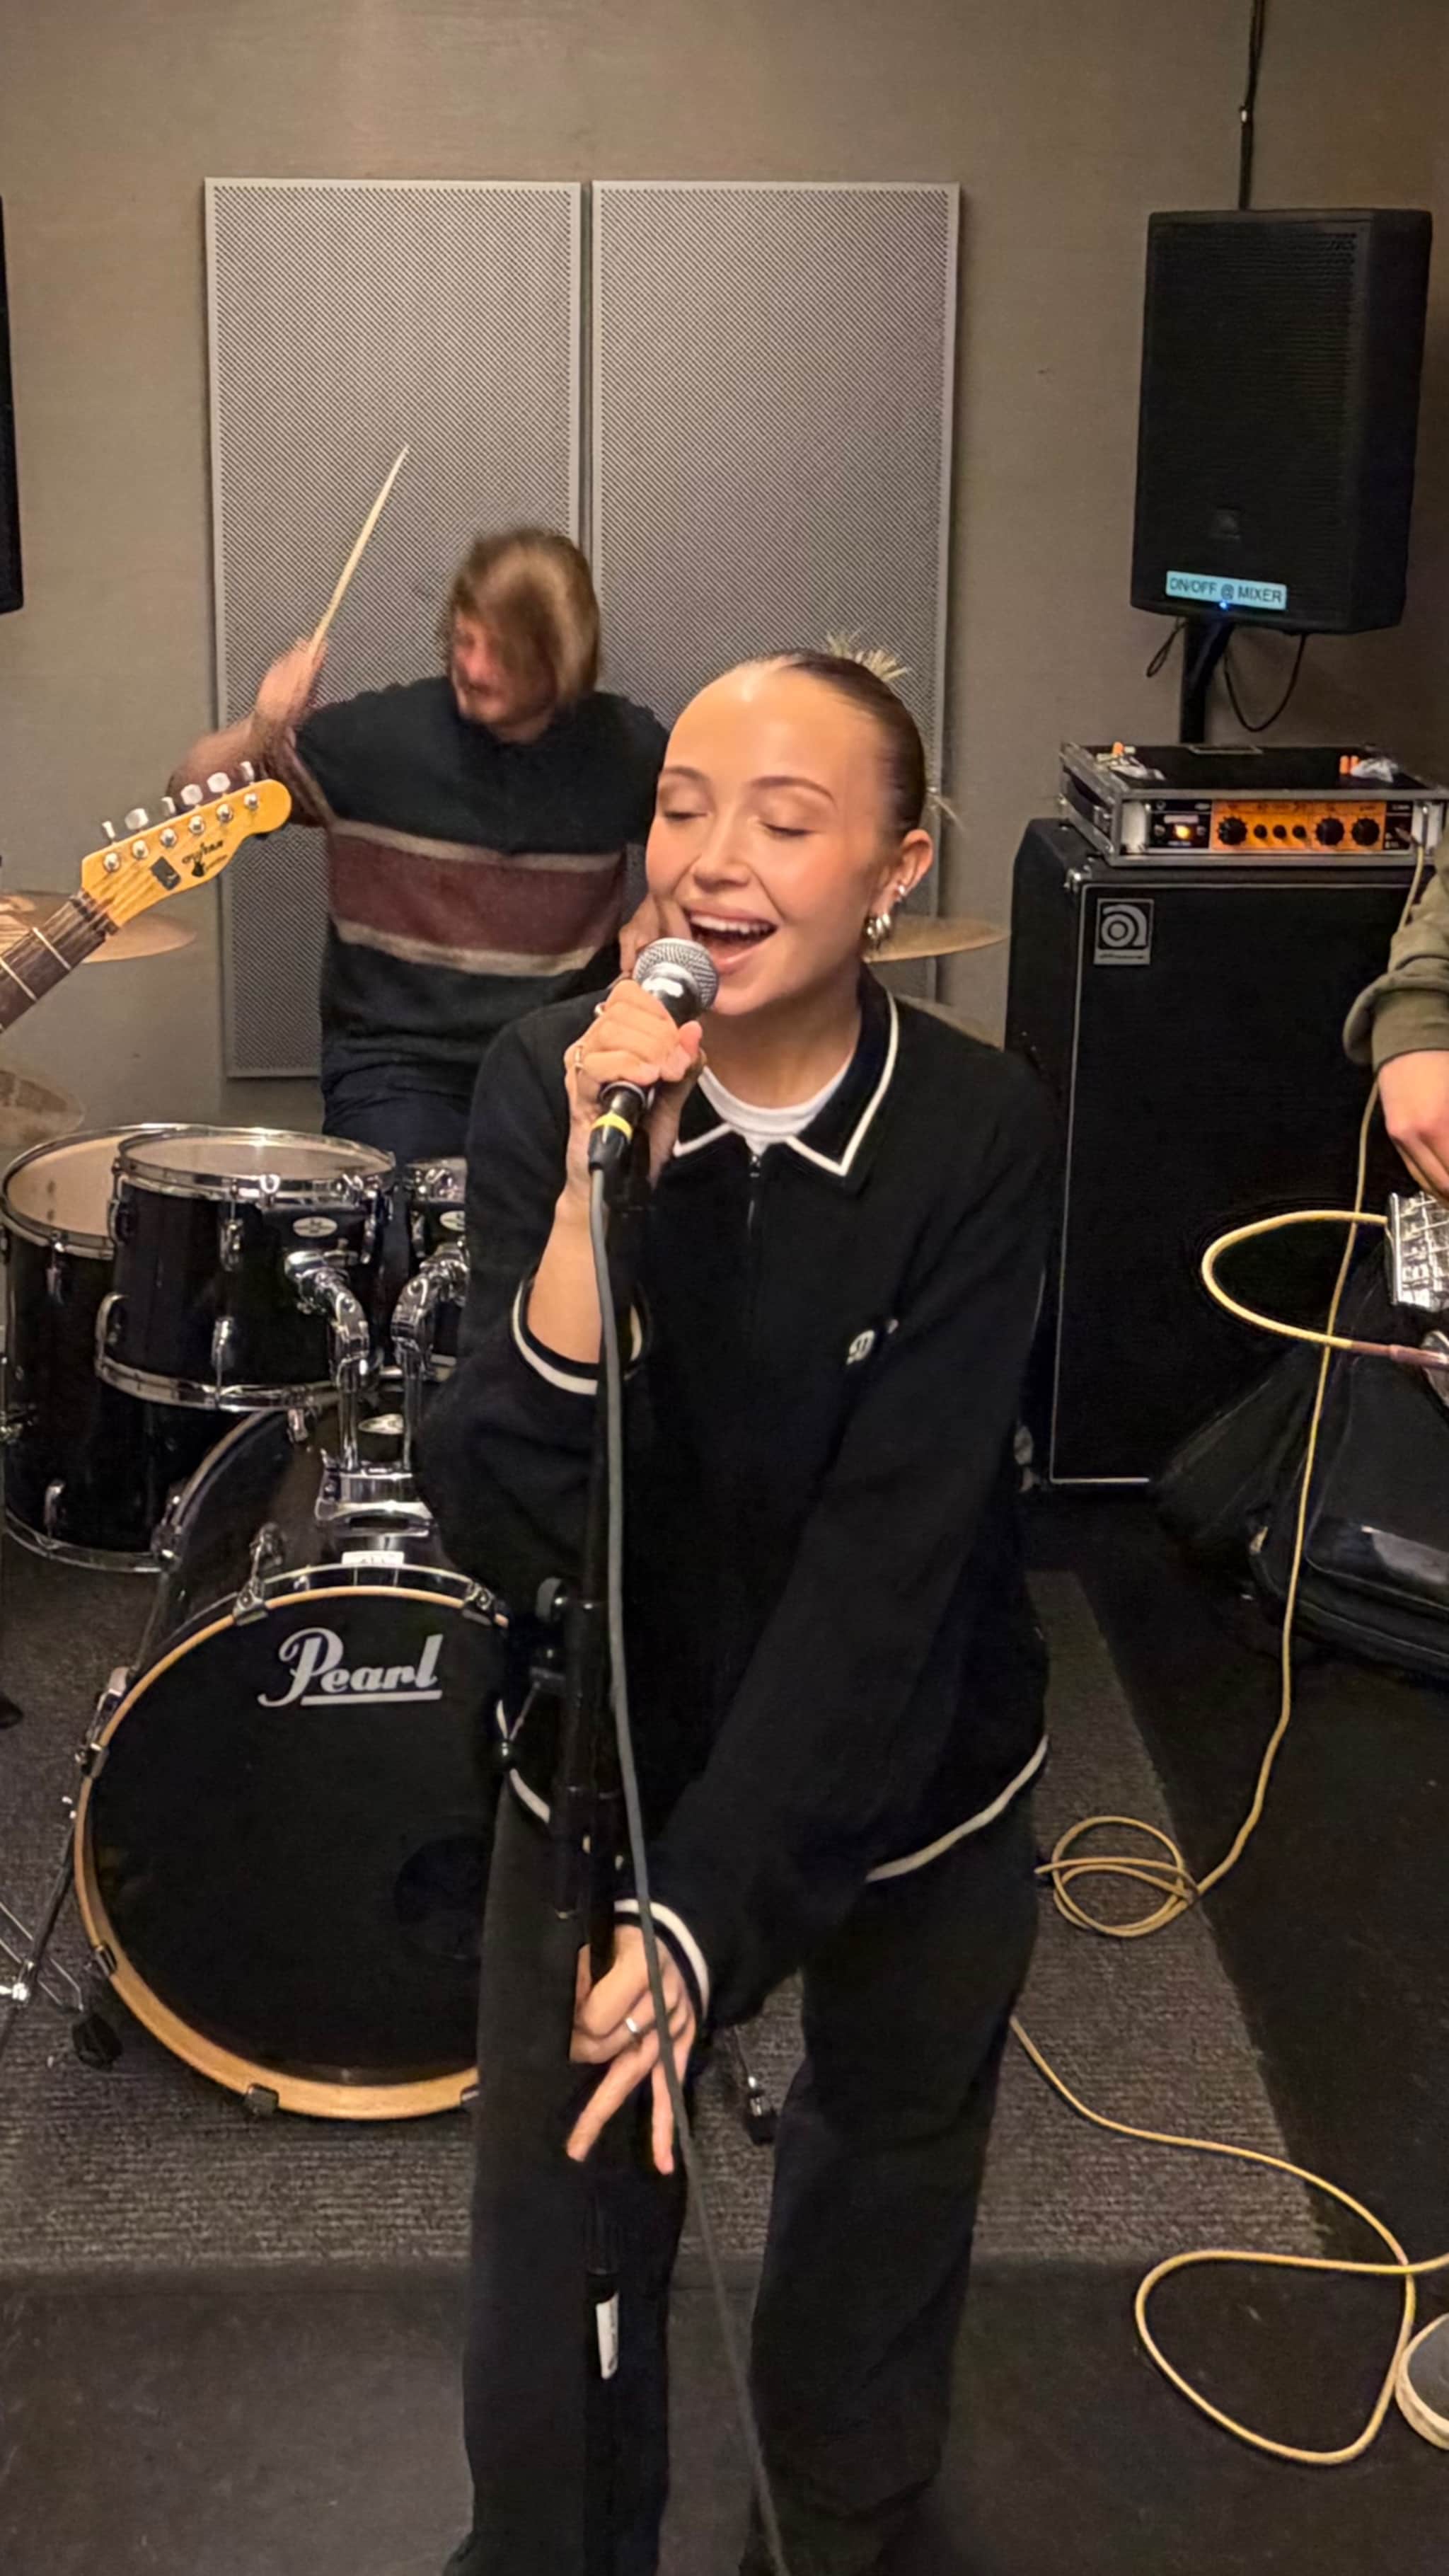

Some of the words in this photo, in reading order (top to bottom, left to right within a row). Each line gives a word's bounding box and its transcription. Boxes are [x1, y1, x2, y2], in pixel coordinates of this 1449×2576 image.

[1170, 577, 1217, 594] ON/OFF
[1220, 584, 1234, 600] @
[1238, 586, 1282, 603] MIXER
[257, 1627, 444, 1707] Pearl
